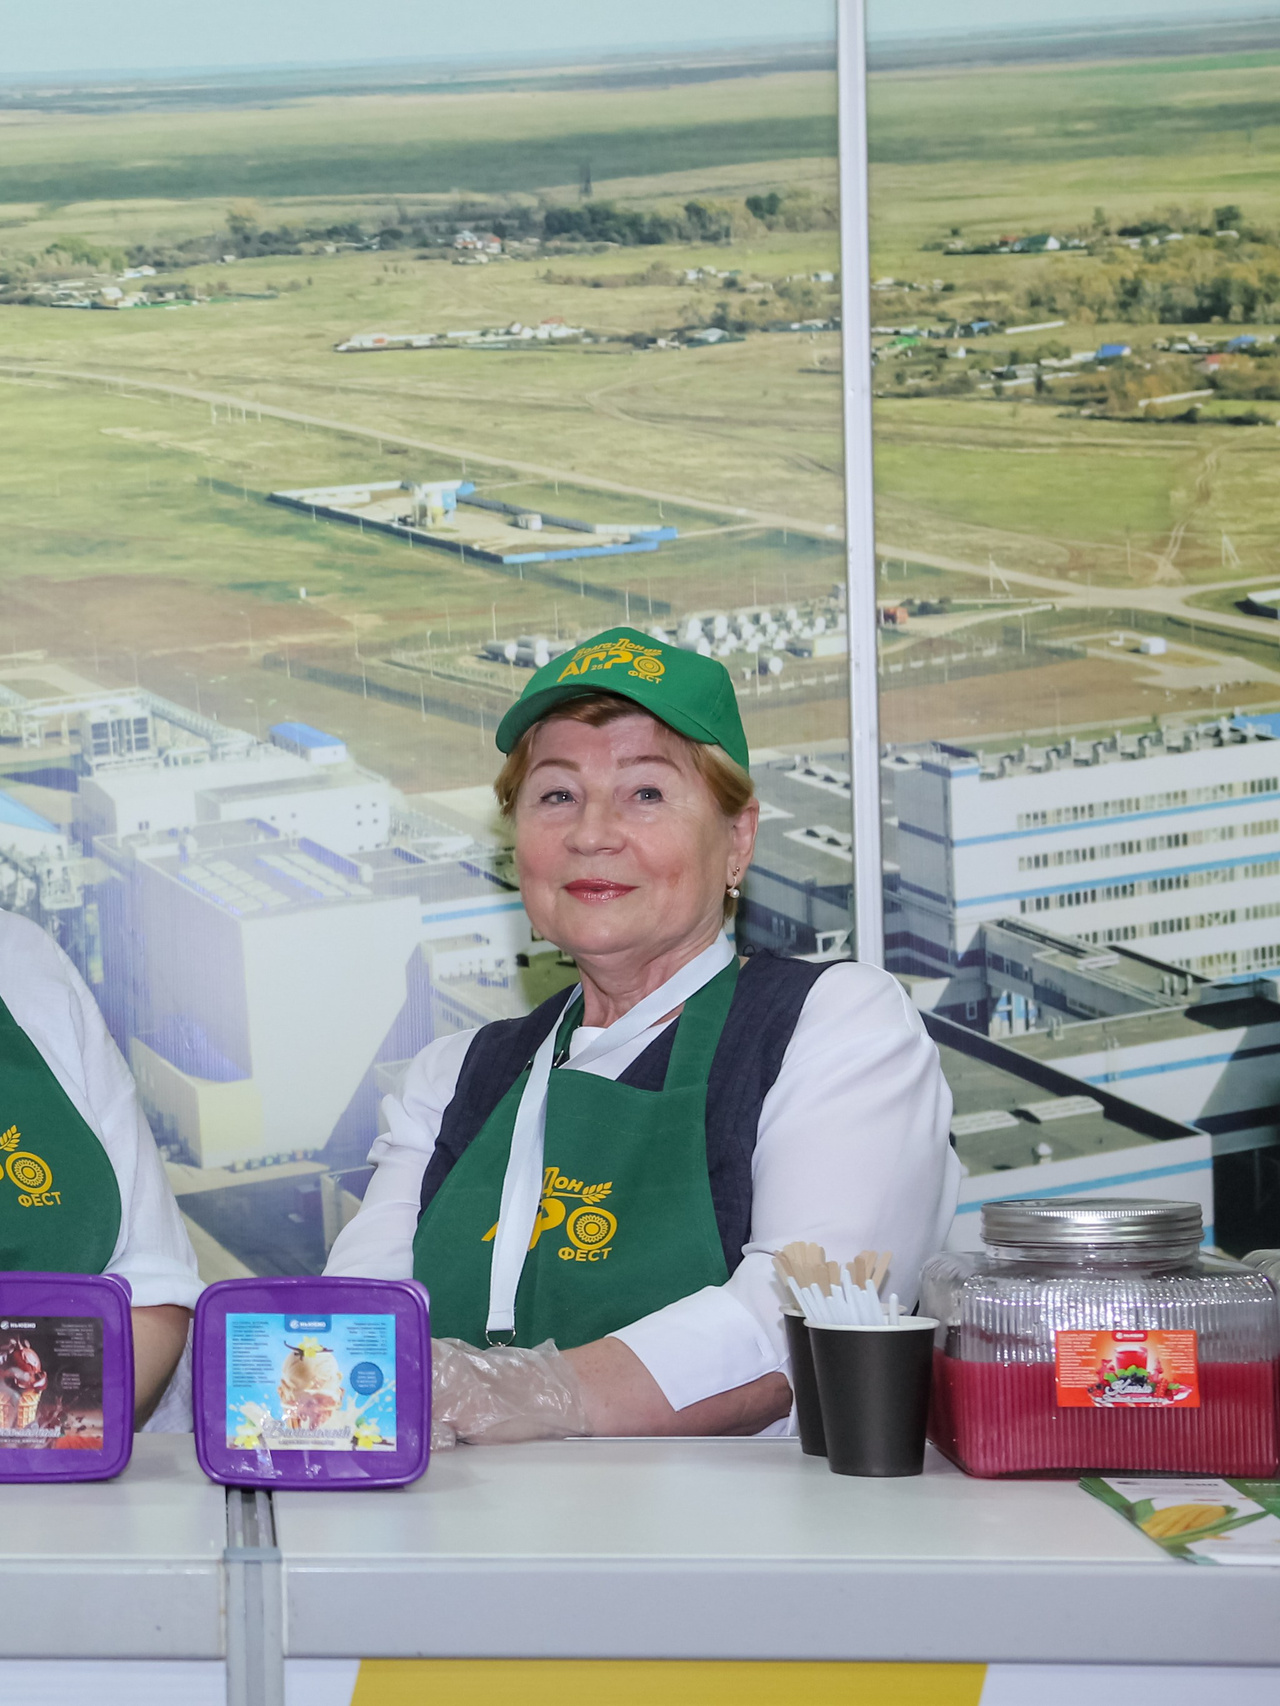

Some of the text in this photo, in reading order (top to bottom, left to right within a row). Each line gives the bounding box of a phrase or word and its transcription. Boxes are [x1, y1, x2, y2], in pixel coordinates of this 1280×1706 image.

[571, 638, 645, 661] Волга-Дон
[627, 670, 663, 684] ФЕСТ
[18, 1191, 62, 1207] ФЕСТ
[558, 1246, 613, 1262] ФЕСТ
